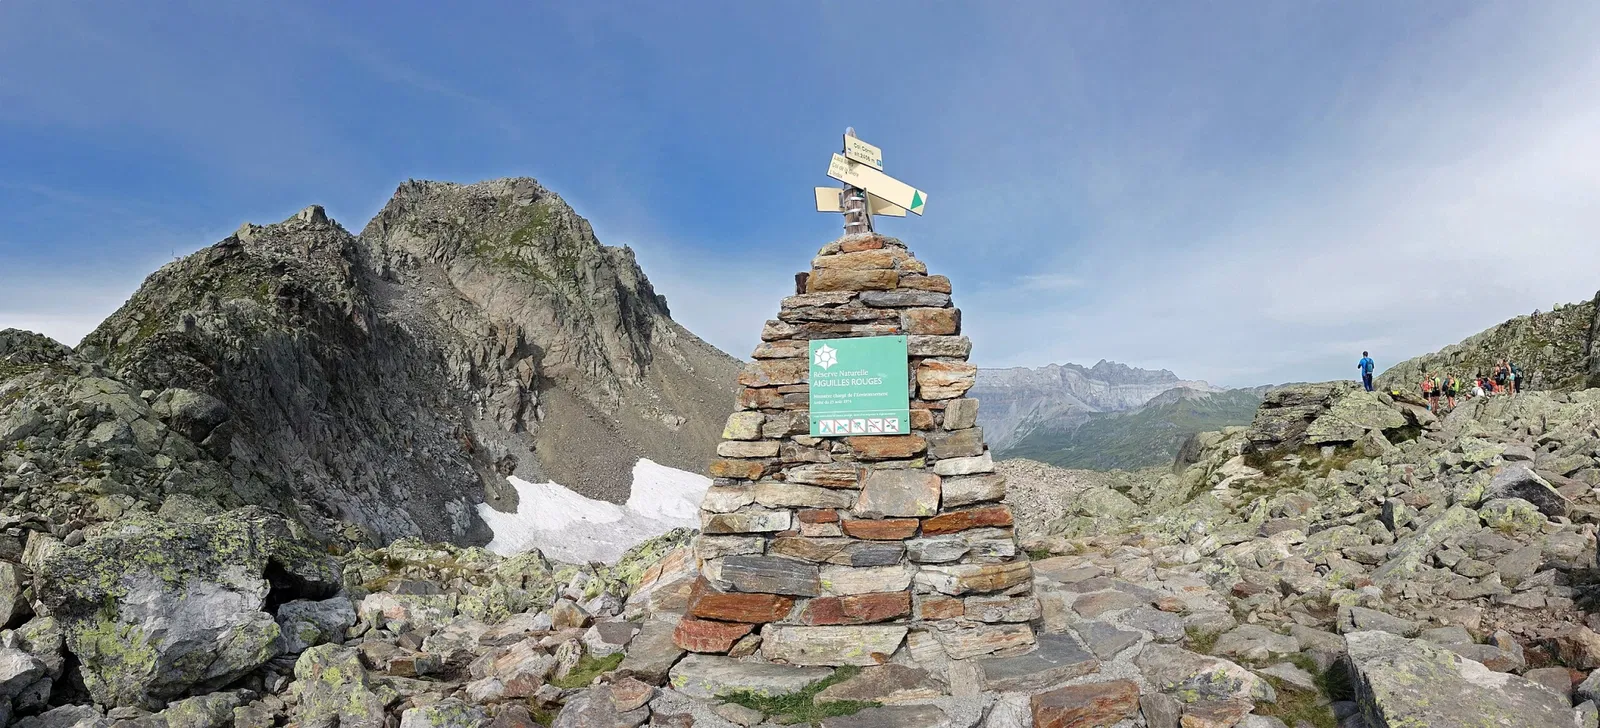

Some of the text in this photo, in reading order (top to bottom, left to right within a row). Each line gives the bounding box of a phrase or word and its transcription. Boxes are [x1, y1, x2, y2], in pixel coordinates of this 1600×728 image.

[839, 369, 869, 377] Naturelle
[813, 377, 883, 387] AIGUILLES ROUGES
